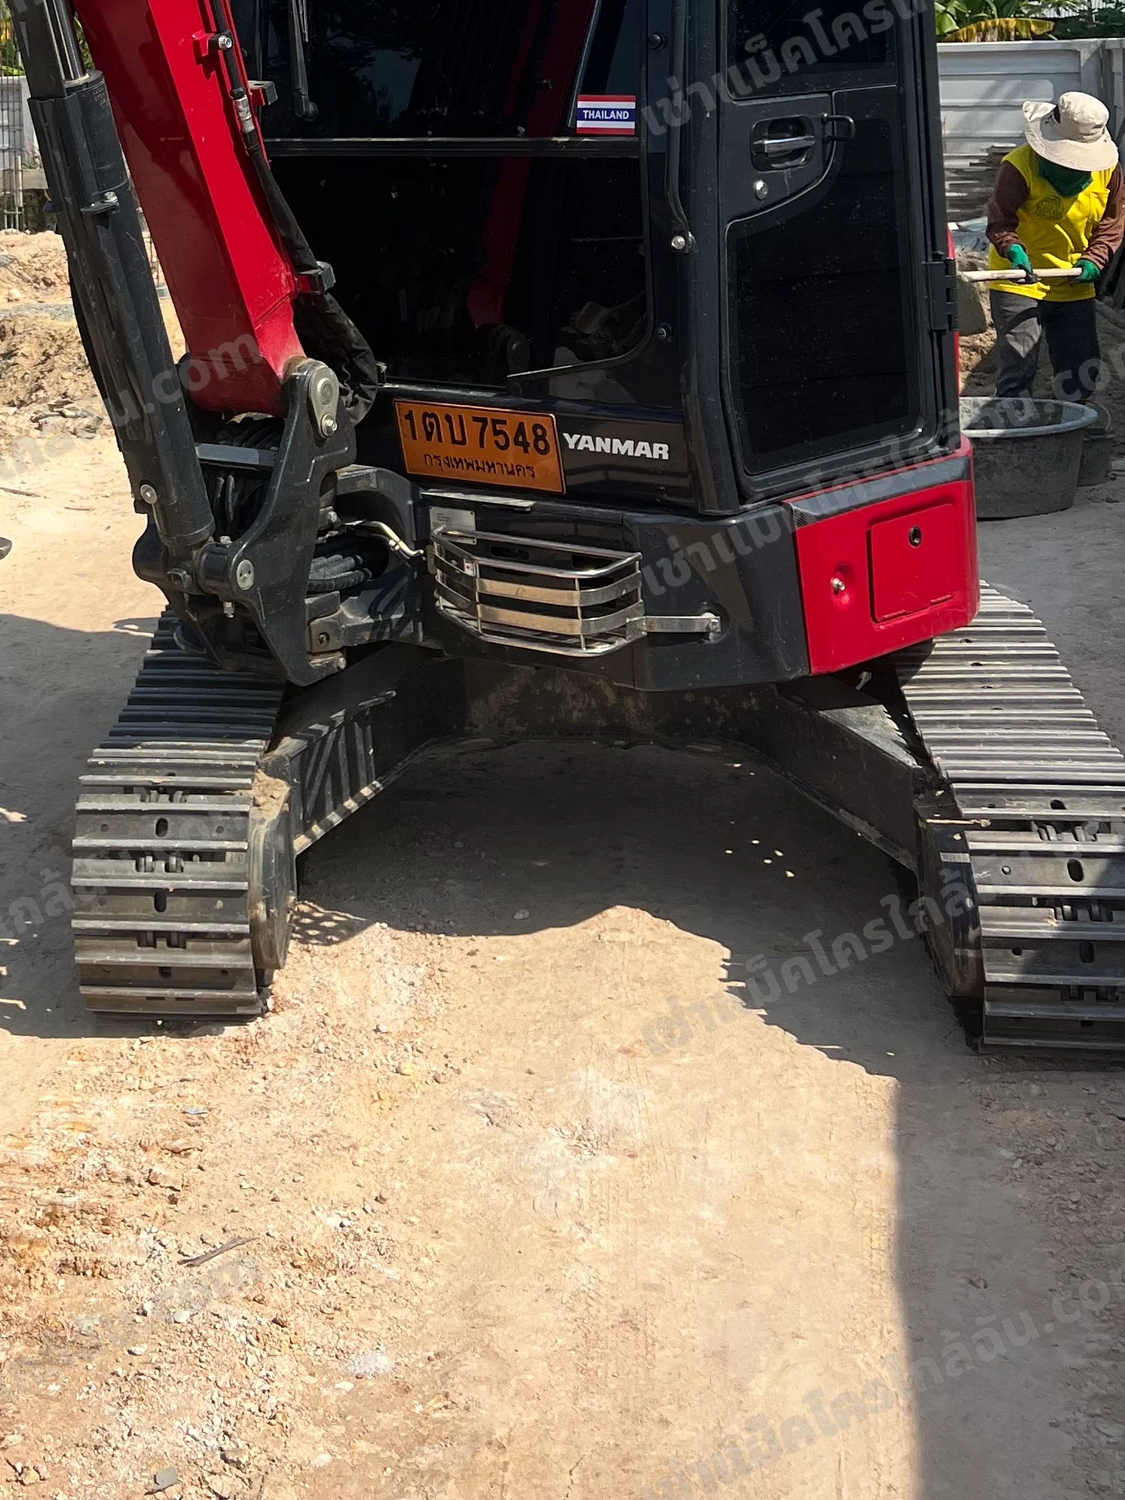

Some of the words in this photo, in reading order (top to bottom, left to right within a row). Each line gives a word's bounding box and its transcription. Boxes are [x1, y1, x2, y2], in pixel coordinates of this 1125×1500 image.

[582, 109, 630, 120] THAILAND
[472, 415, 551, 456] 7548
[562, 432, 670, 461] YANMAR
[423, 452, 536, 478] กรุงเทพมหานคร
